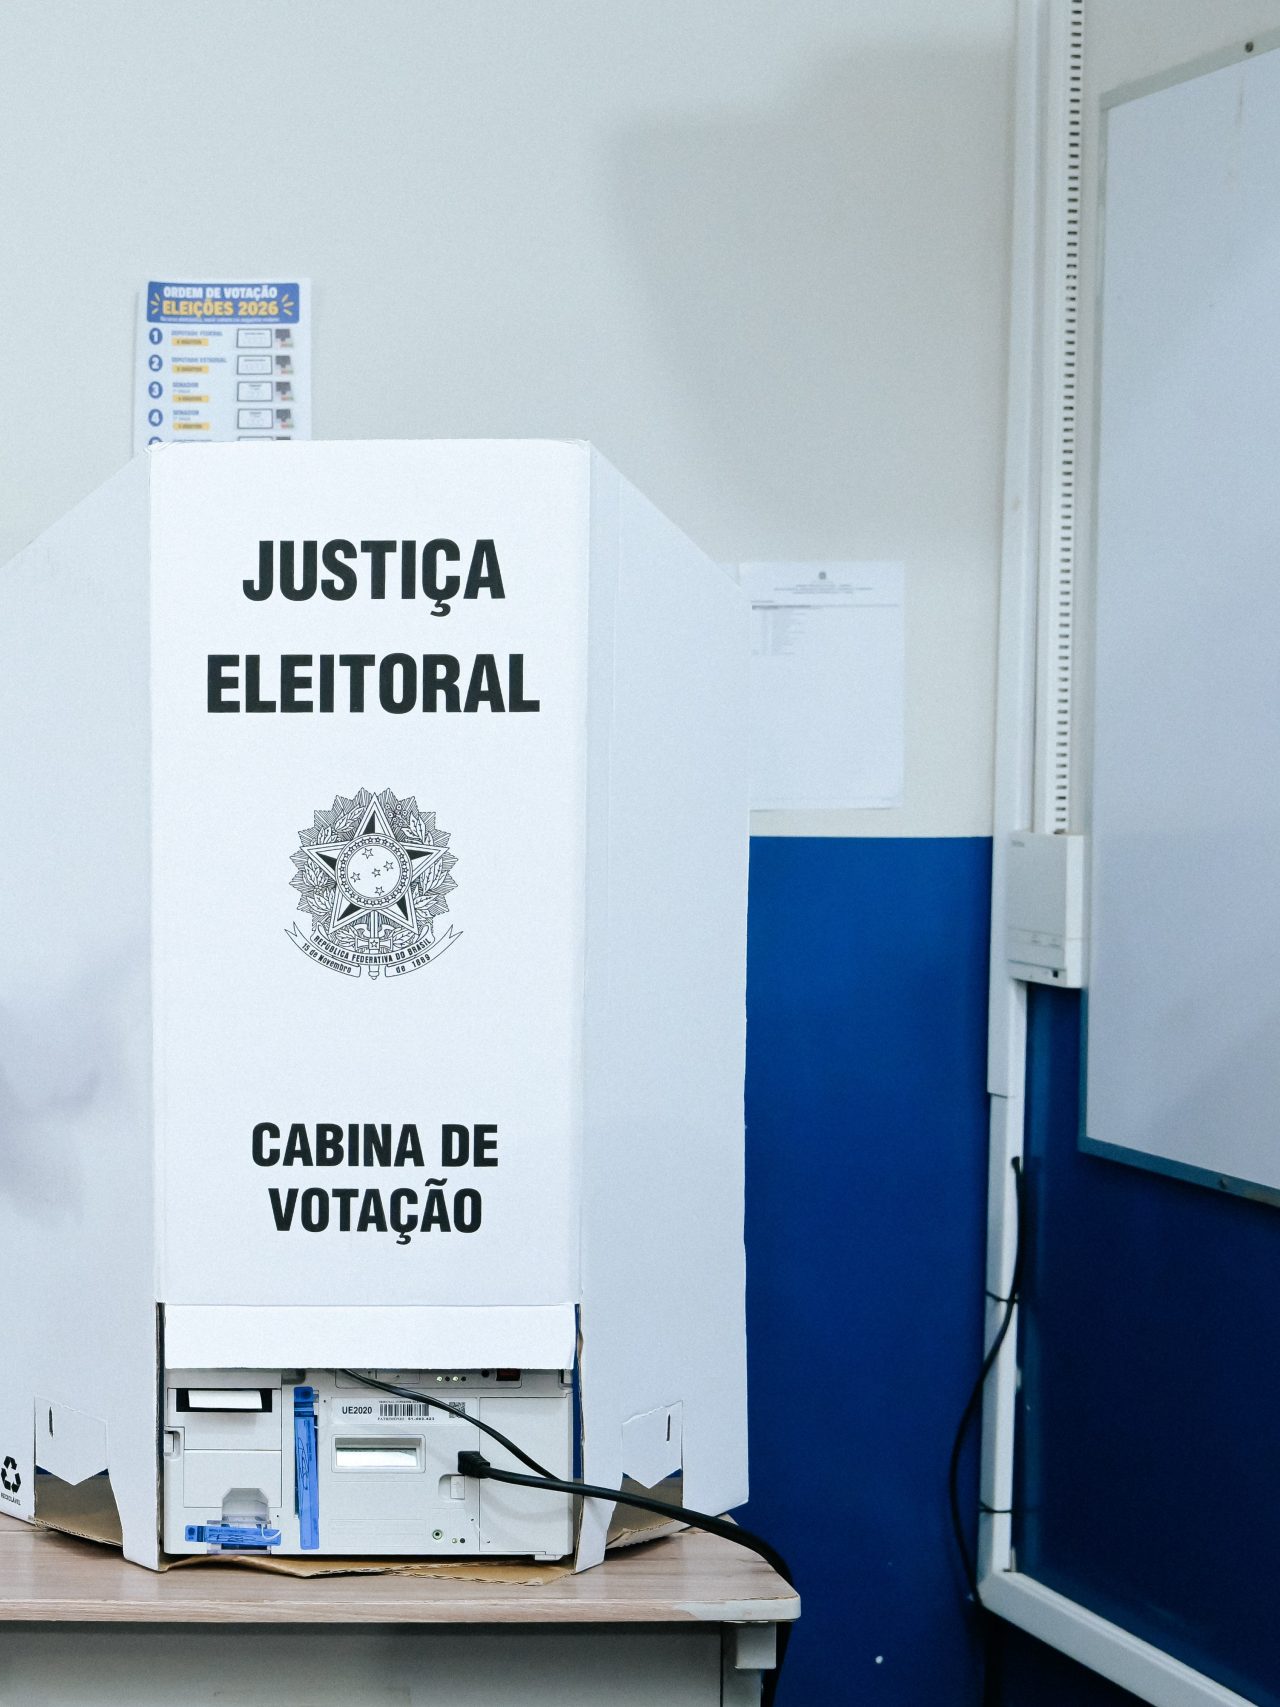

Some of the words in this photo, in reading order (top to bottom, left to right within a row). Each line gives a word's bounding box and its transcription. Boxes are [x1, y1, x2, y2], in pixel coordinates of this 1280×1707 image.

[163, 286, 203, 299] ORDEM
[206, 287, 221, 299] DE
[223, 285, 278, 302] VOTAÇÃO
[162, 298, 234, 318] ELEIÇÕES
[238, 301, 279, 316] 2026
[243, 538, 505, 617] JUSTIÇA
[207, 653, 540, 714] ELEITORAL
[352, 953, 393, 964] FEDERATIVA
[395, 951, 405, 960] DO
[407, 938, 431, 955] BRASIL
[412, 953, 431, 968] 1889
[252, 1122, 425, 1167] CABINA
[441, 1124, 498, 1167] DE
[268, 1178, 482, 1245] VOTAÇÃO
[341, 1406, 373, 1415] UE2020
